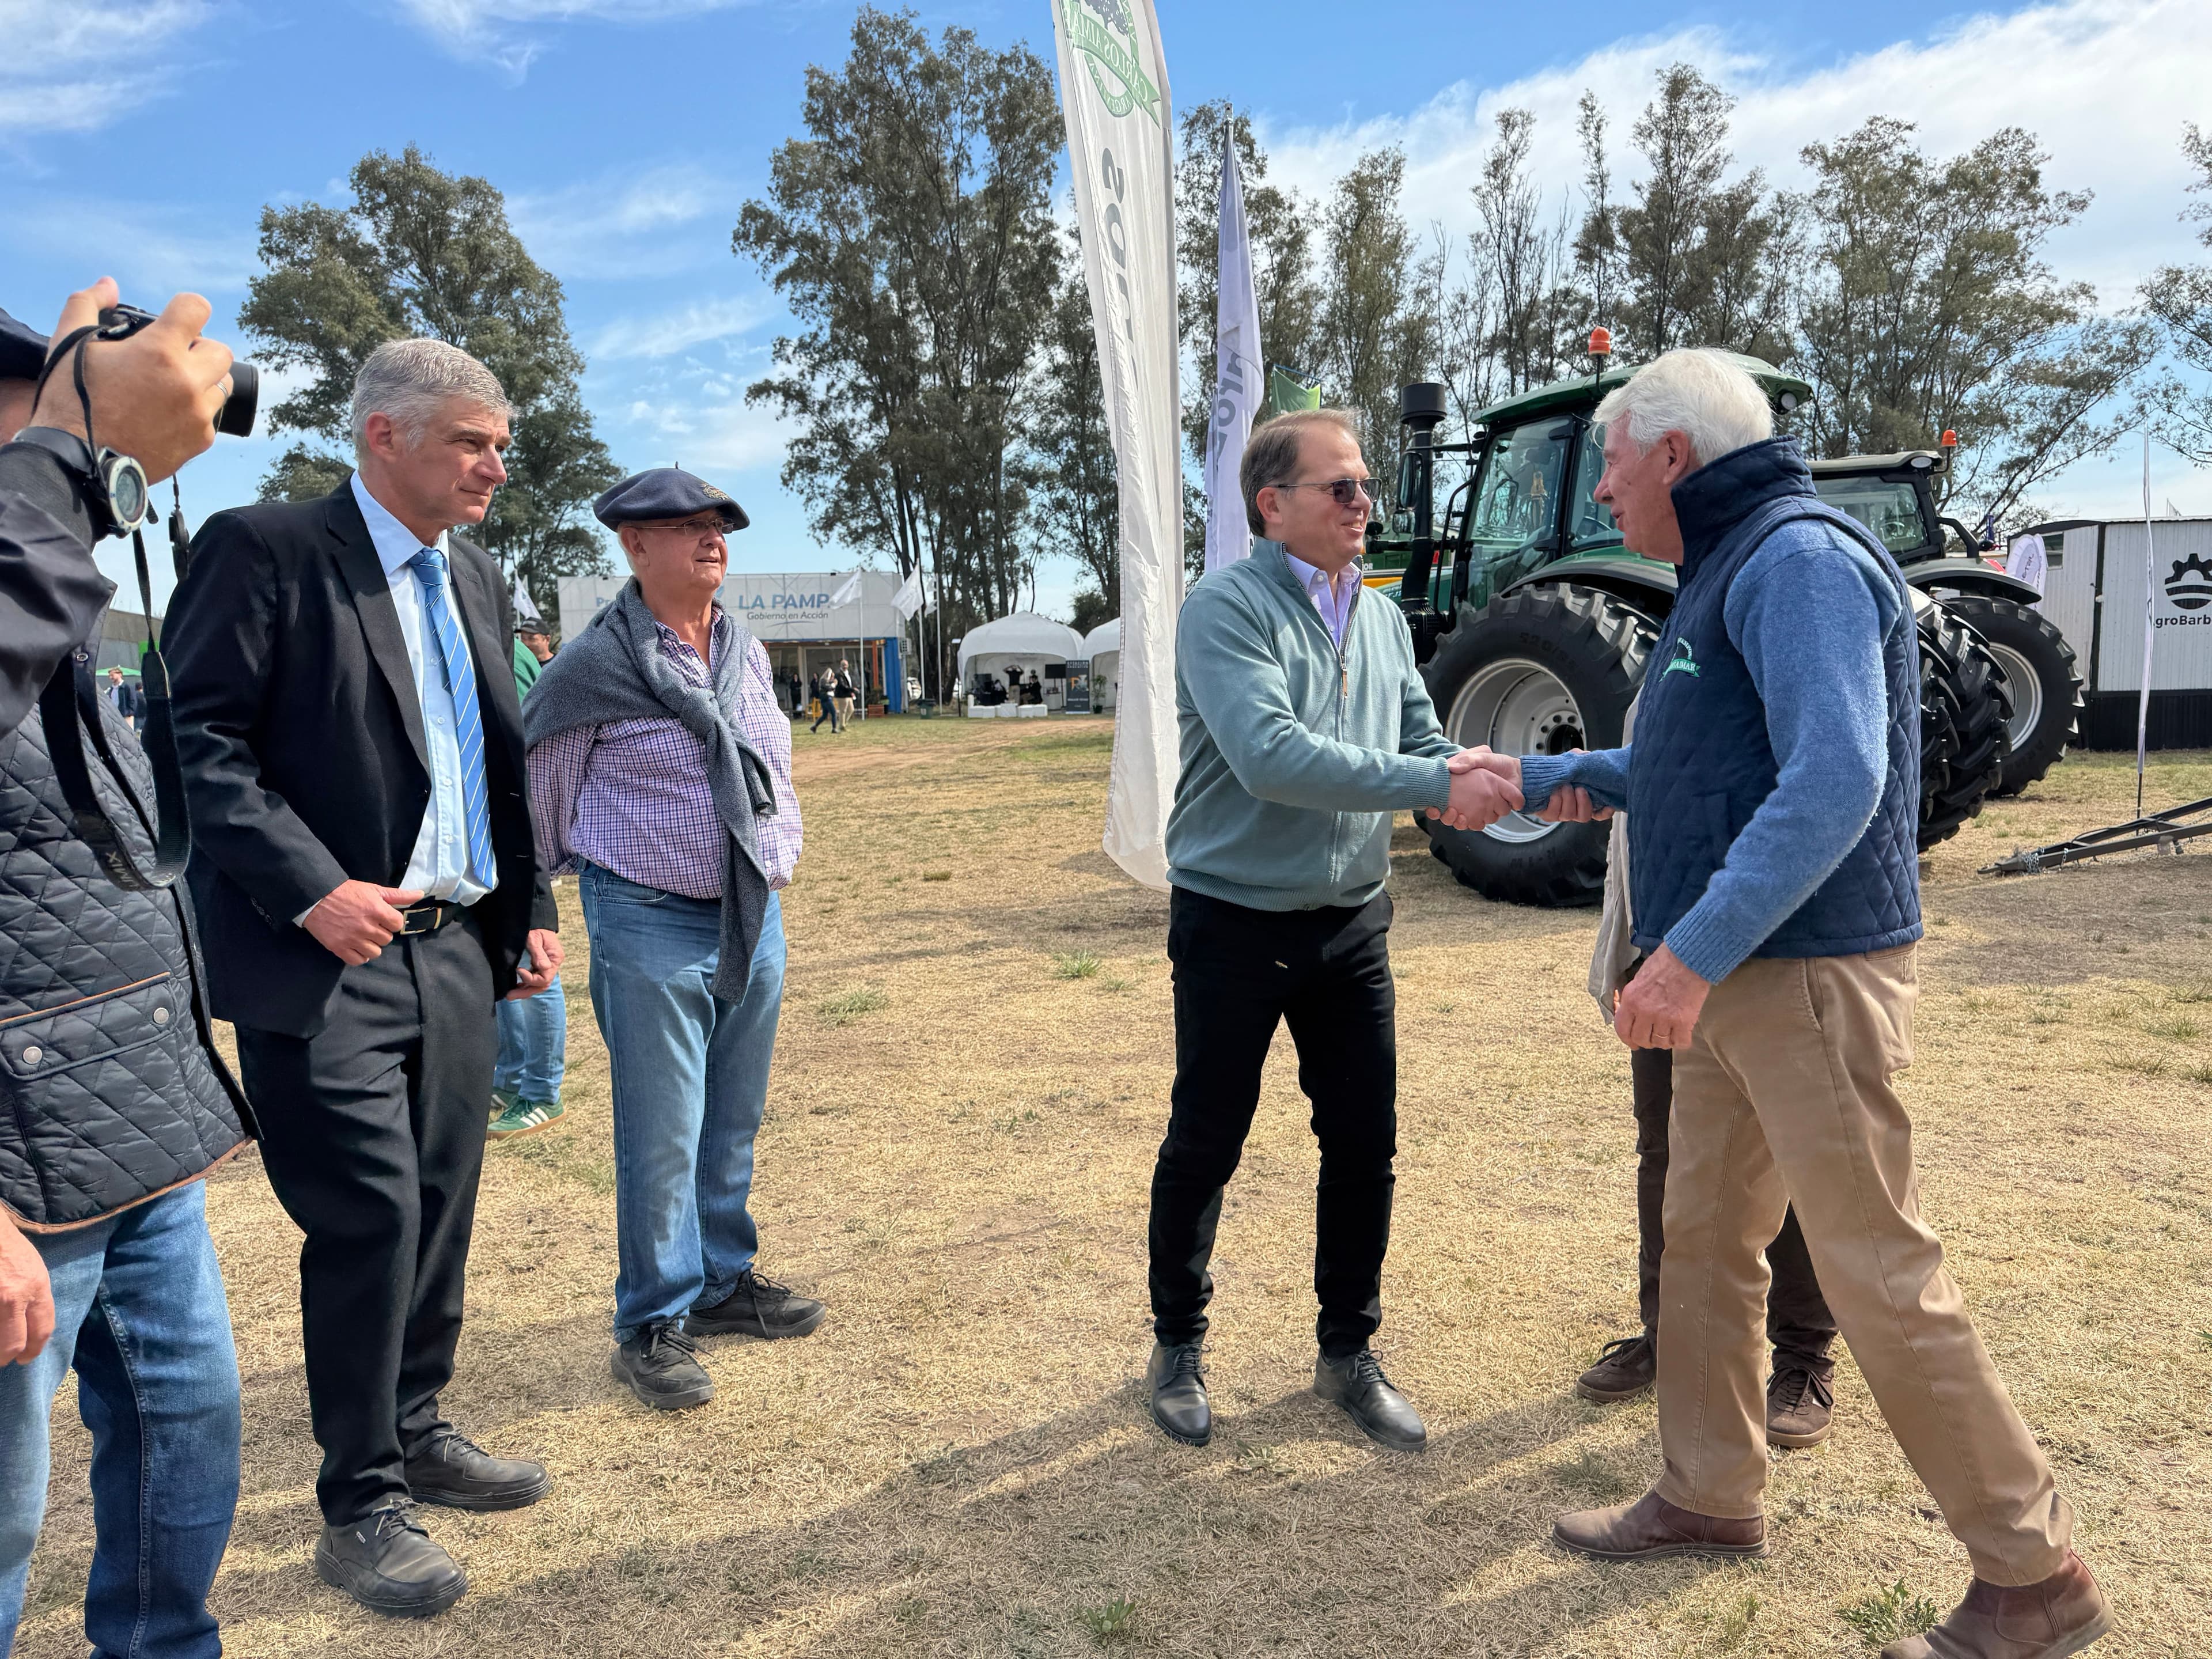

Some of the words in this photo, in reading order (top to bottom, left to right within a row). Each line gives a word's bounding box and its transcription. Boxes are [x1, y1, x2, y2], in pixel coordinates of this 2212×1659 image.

[738, 594, 766, 609] LA
[771, 593, 831, 609] PAMP
[747, 612, 786, 620] Gobierno
[800, 611, 829, 619] Acción
[2153, 614, 2211, 629] groBarb
